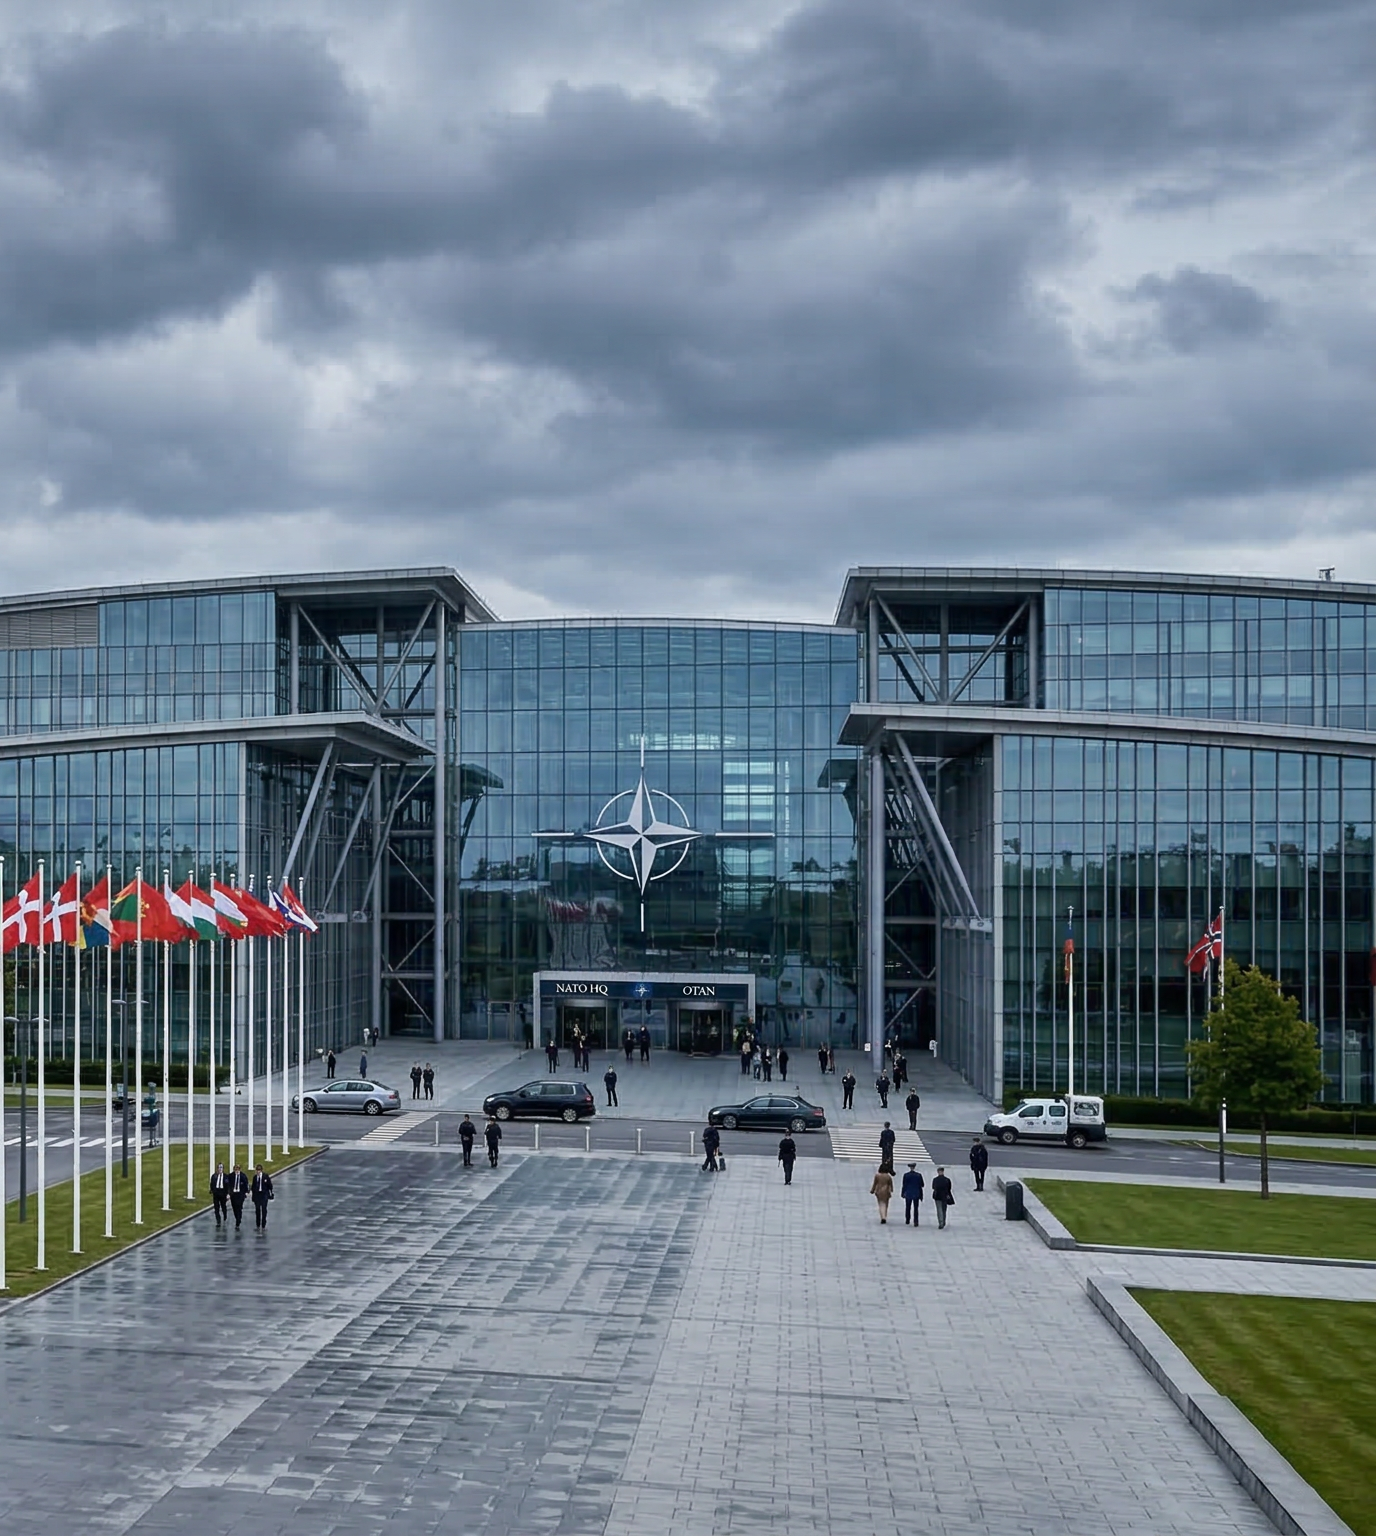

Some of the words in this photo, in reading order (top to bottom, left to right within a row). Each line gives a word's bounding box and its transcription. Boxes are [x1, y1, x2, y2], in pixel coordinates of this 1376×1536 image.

[556, 983, 588, 993] NATO
[590, 984, 609, 996] HQ
[682, 985, 715, 996] OTAN
